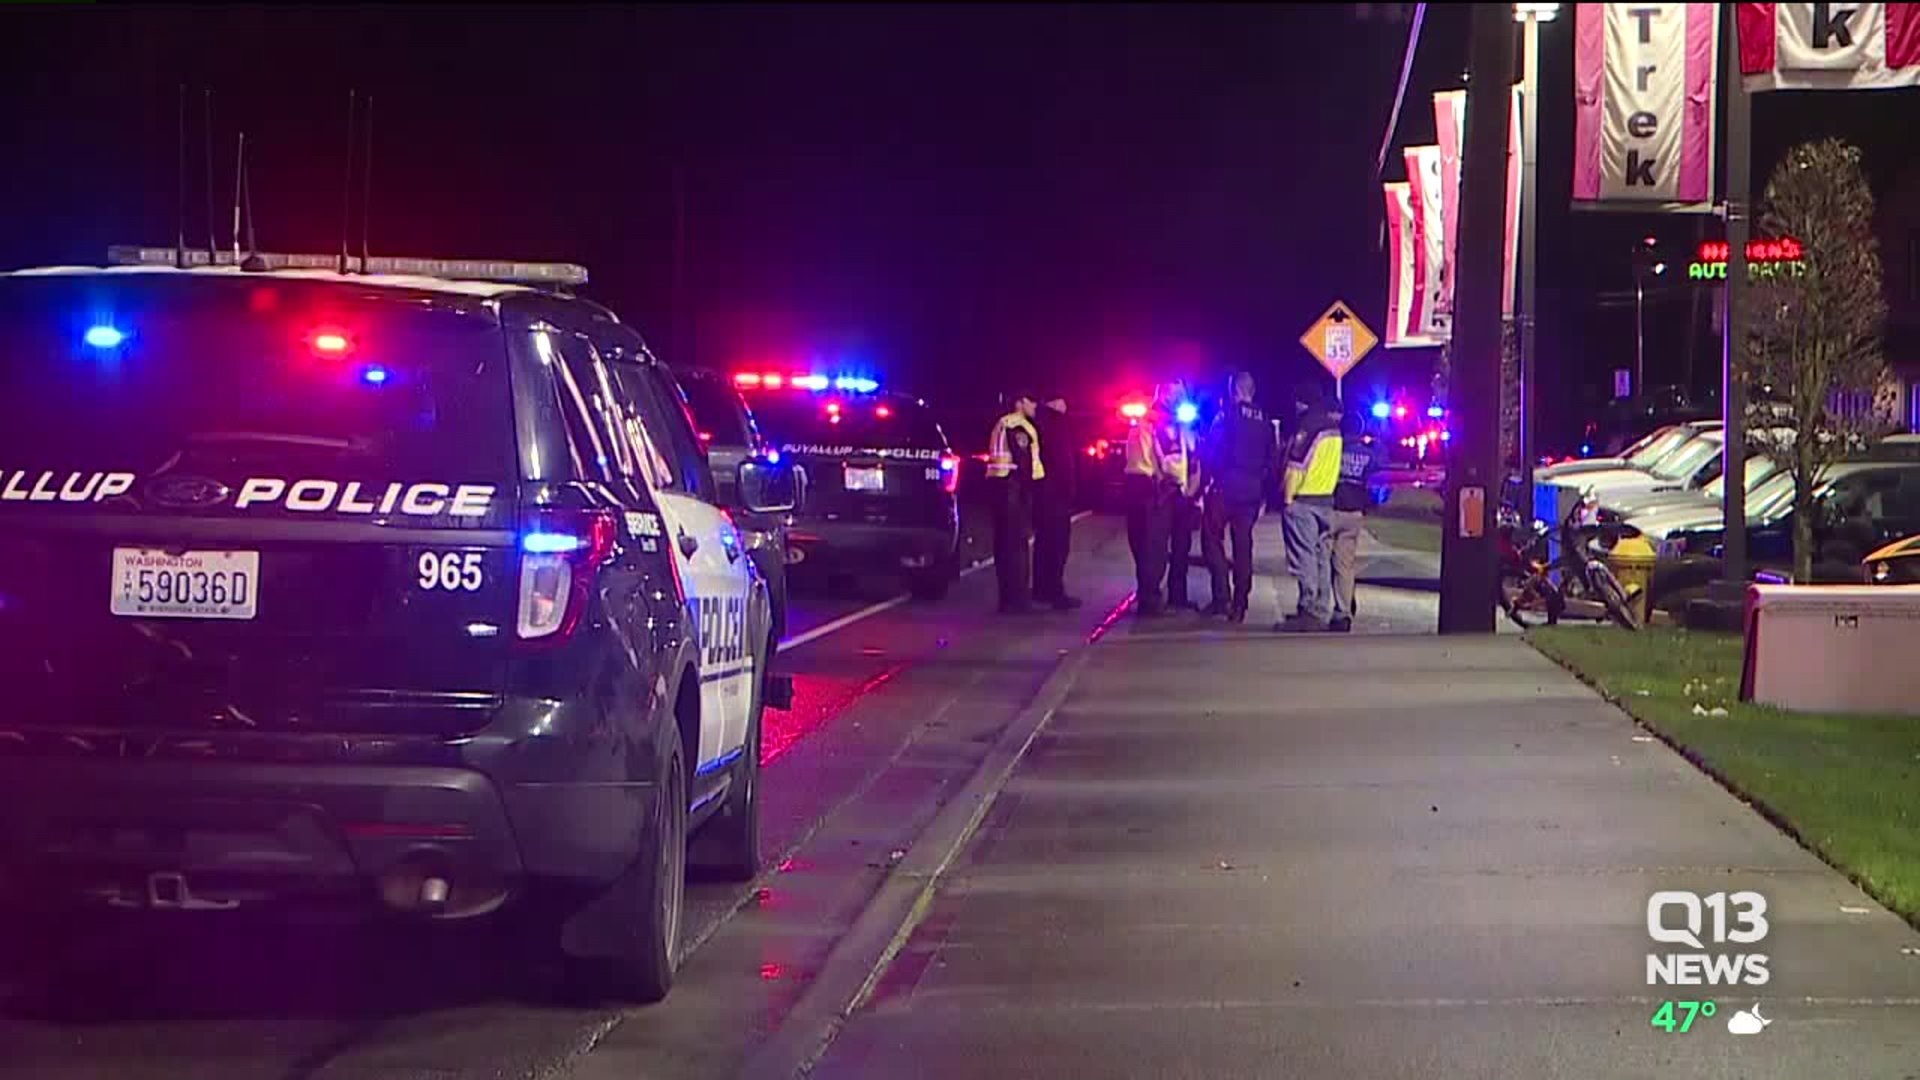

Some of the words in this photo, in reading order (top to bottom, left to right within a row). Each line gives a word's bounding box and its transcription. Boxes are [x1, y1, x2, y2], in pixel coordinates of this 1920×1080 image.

[1625, 8, 1661, 187] Trek
[1328, 344, 1350, 358] 35
[782, 443, 853, 456] PUYALLUP
[0, 470, 136, 502] LLUP
[235, 478, 495, 516] POLICE
[125, 555, 203, 568] WASHINGTON
[418, 552, 482, 590] 965
[138, 570, 247, 605] 59036D
